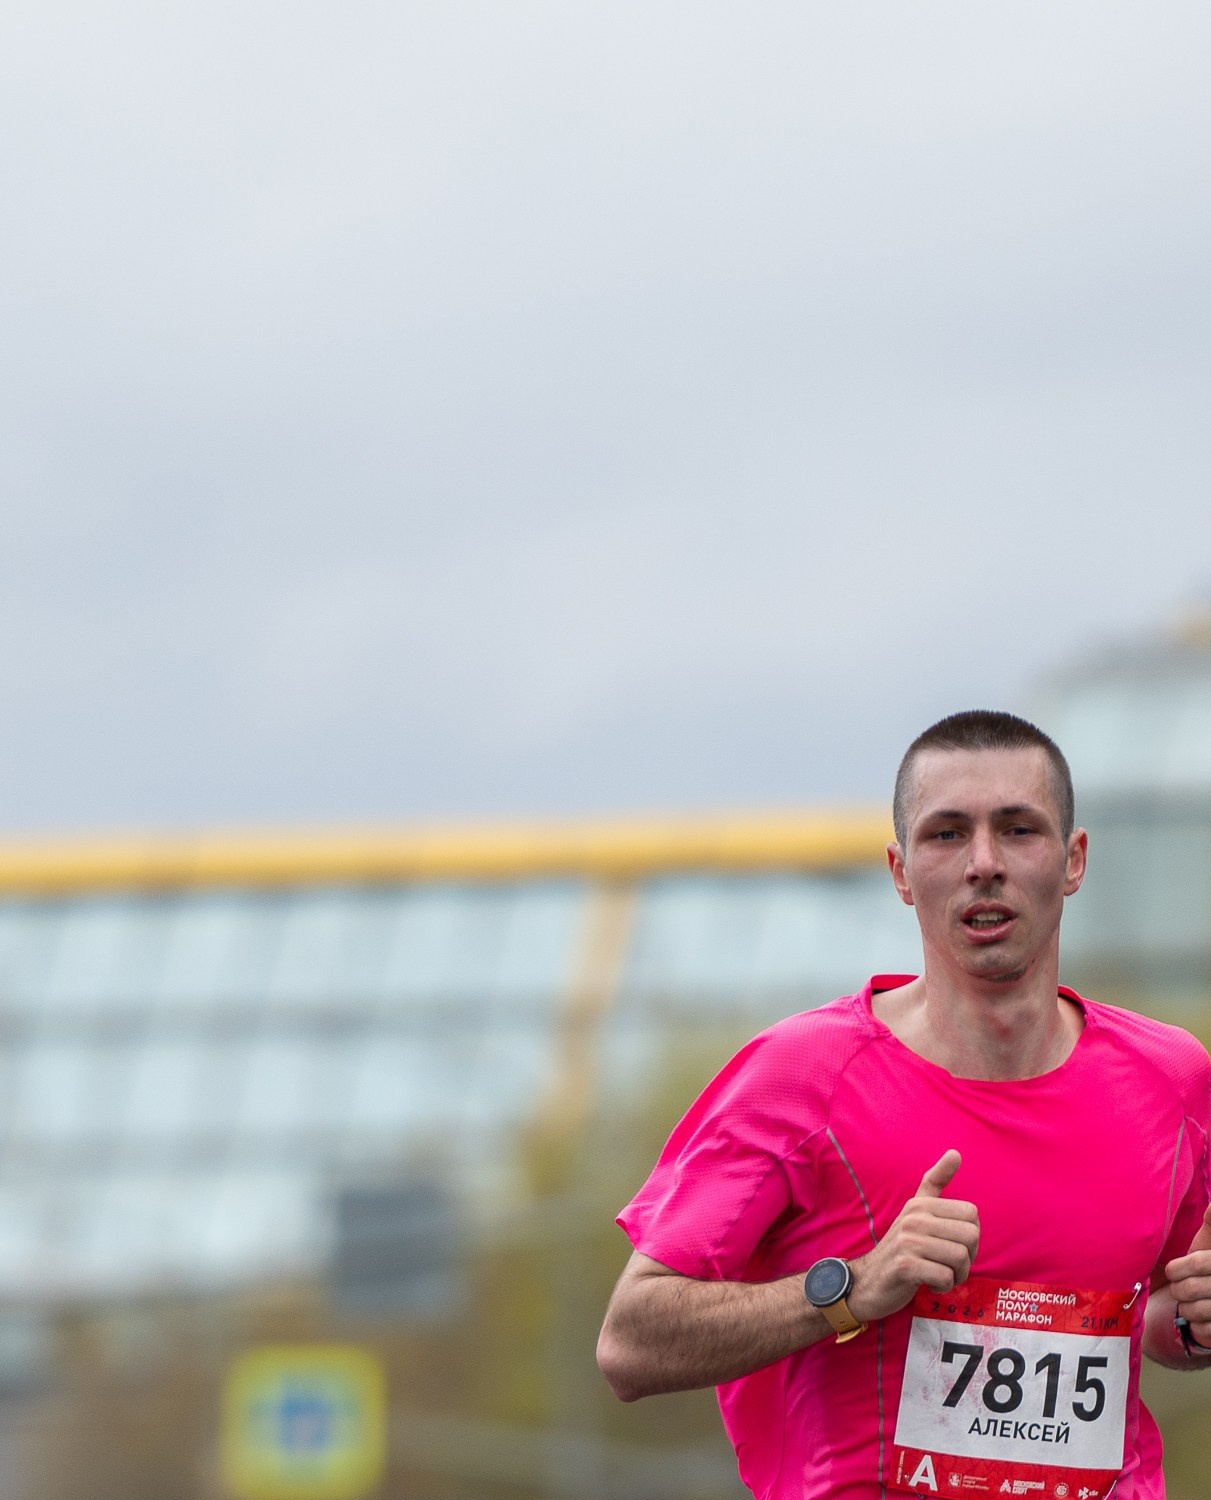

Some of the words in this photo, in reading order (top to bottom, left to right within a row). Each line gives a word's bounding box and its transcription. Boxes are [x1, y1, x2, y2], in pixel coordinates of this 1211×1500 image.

[996, 1299, 1030, 1312] ПОЛУ
[998, 1287, 1076, 1306] МОСКОВСКИЙ
[996, 1310, 1052, 1325] МАРАФОН
[941, 1340, 1108, 1422] 7815
[968, 1417, 1070, 1444] АЛЕКСЕЙ
